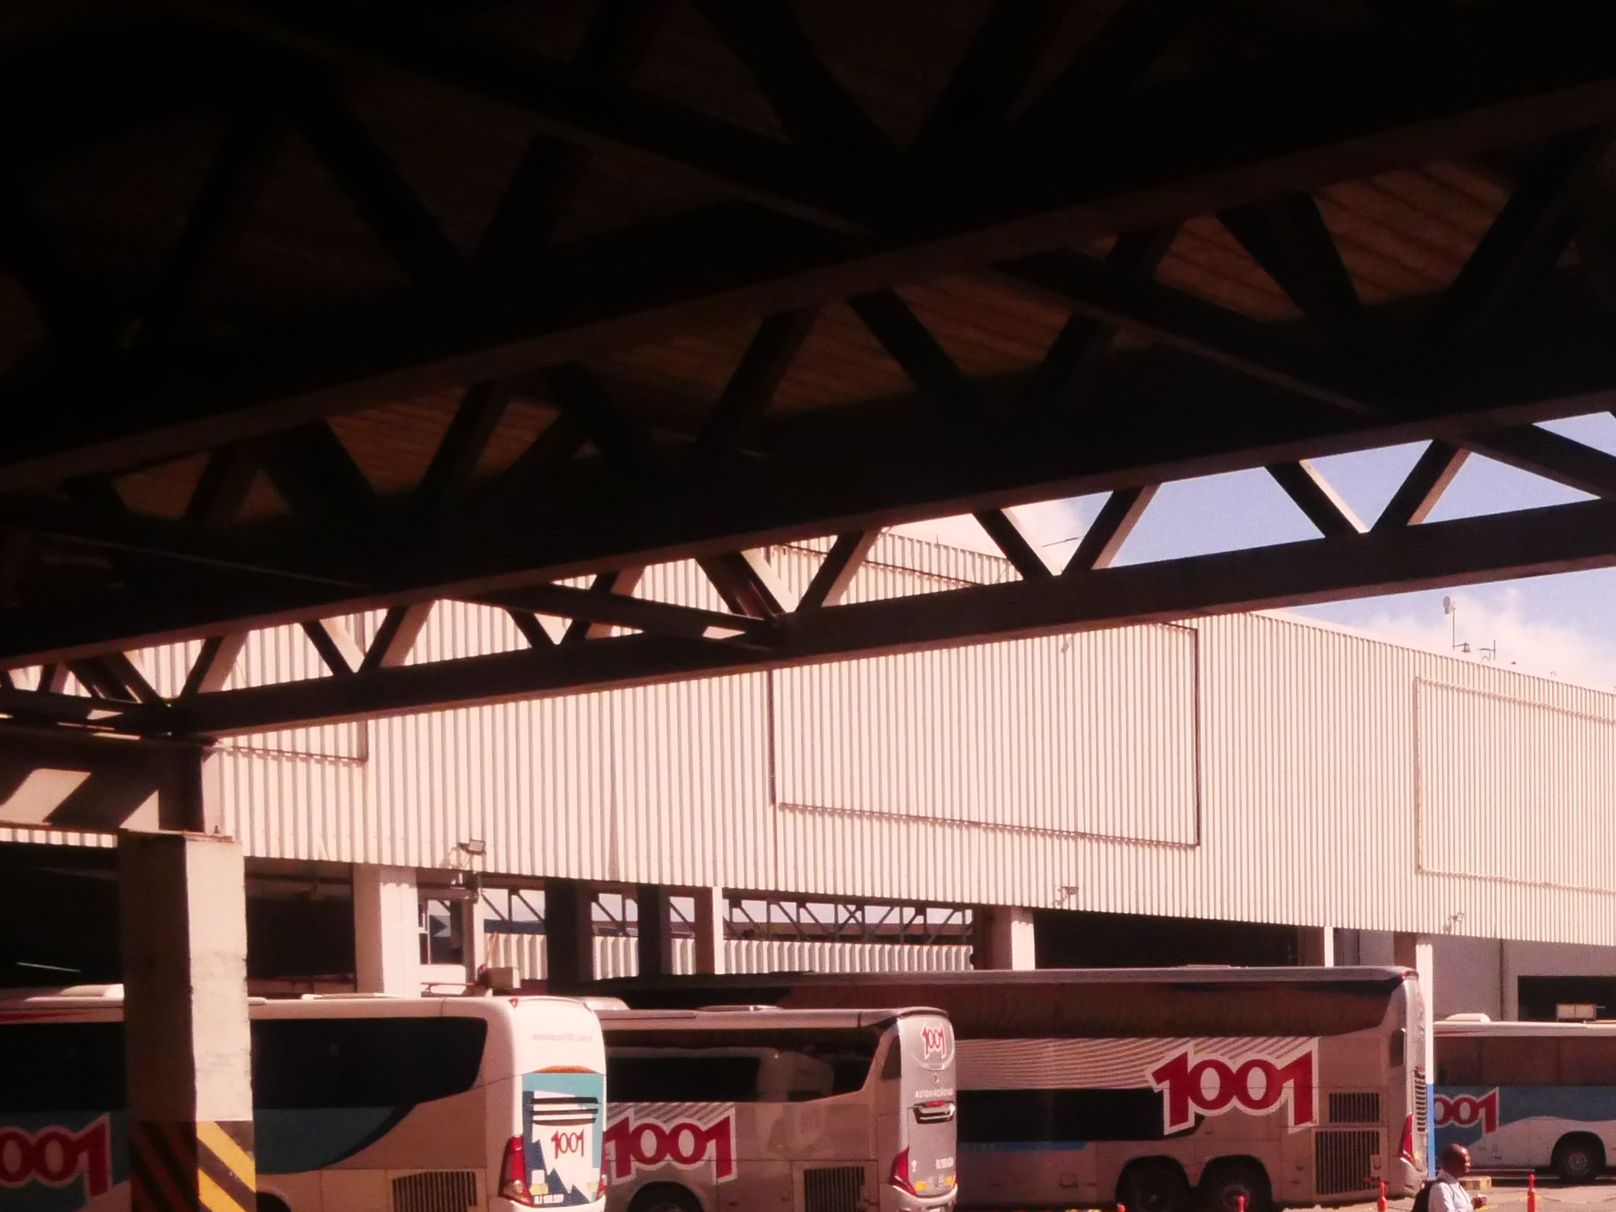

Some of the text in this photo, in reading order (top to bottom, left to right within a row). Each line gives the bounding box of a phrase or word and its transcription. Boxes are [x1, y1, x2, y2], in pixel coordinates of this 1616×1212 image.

[922, 1026, 947, 1057] 1001
[1150, 1049, 1316, 1129] 1001
[551, 1128, 584, 1159] 1001
[602, 1114, 734, 1179] 1001
